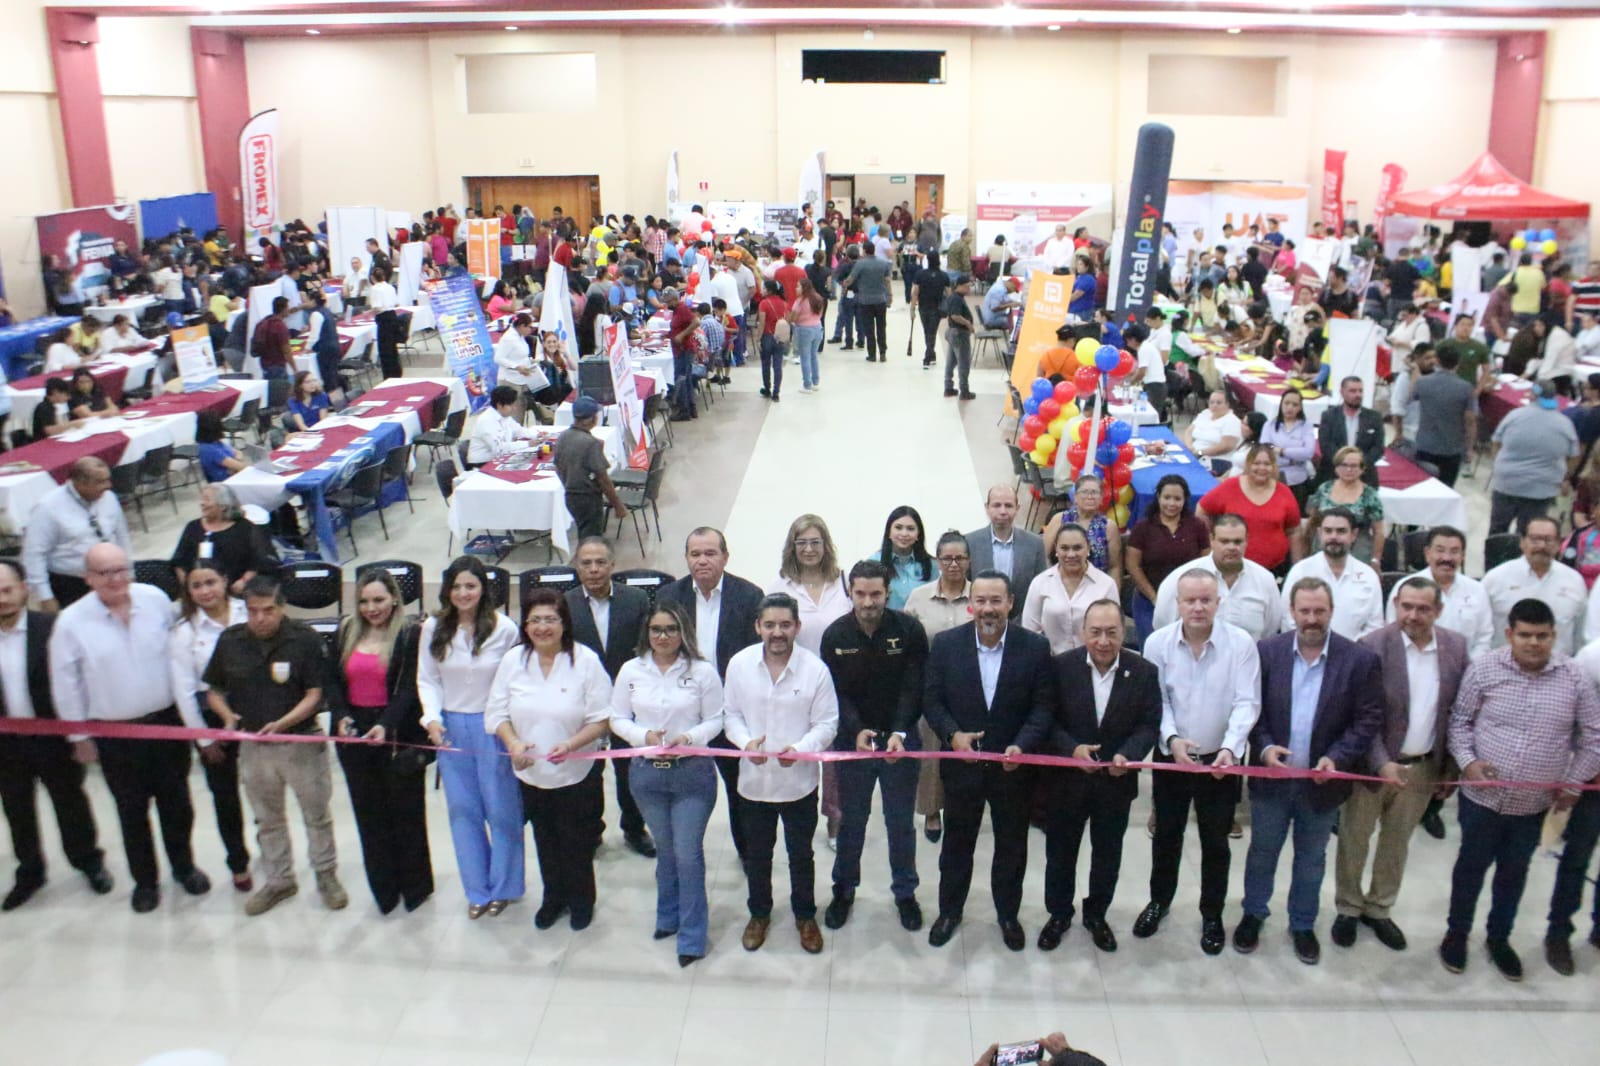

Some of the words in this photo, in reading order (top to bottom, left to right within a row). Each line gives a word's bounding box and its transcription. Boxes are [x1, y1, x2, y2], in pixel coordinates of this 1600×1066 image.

[252, 139, 269, 216] FROMEX
[1125, 202, 1161, 309] Totalplay
[1225, 211, 1288, 237] UAT
